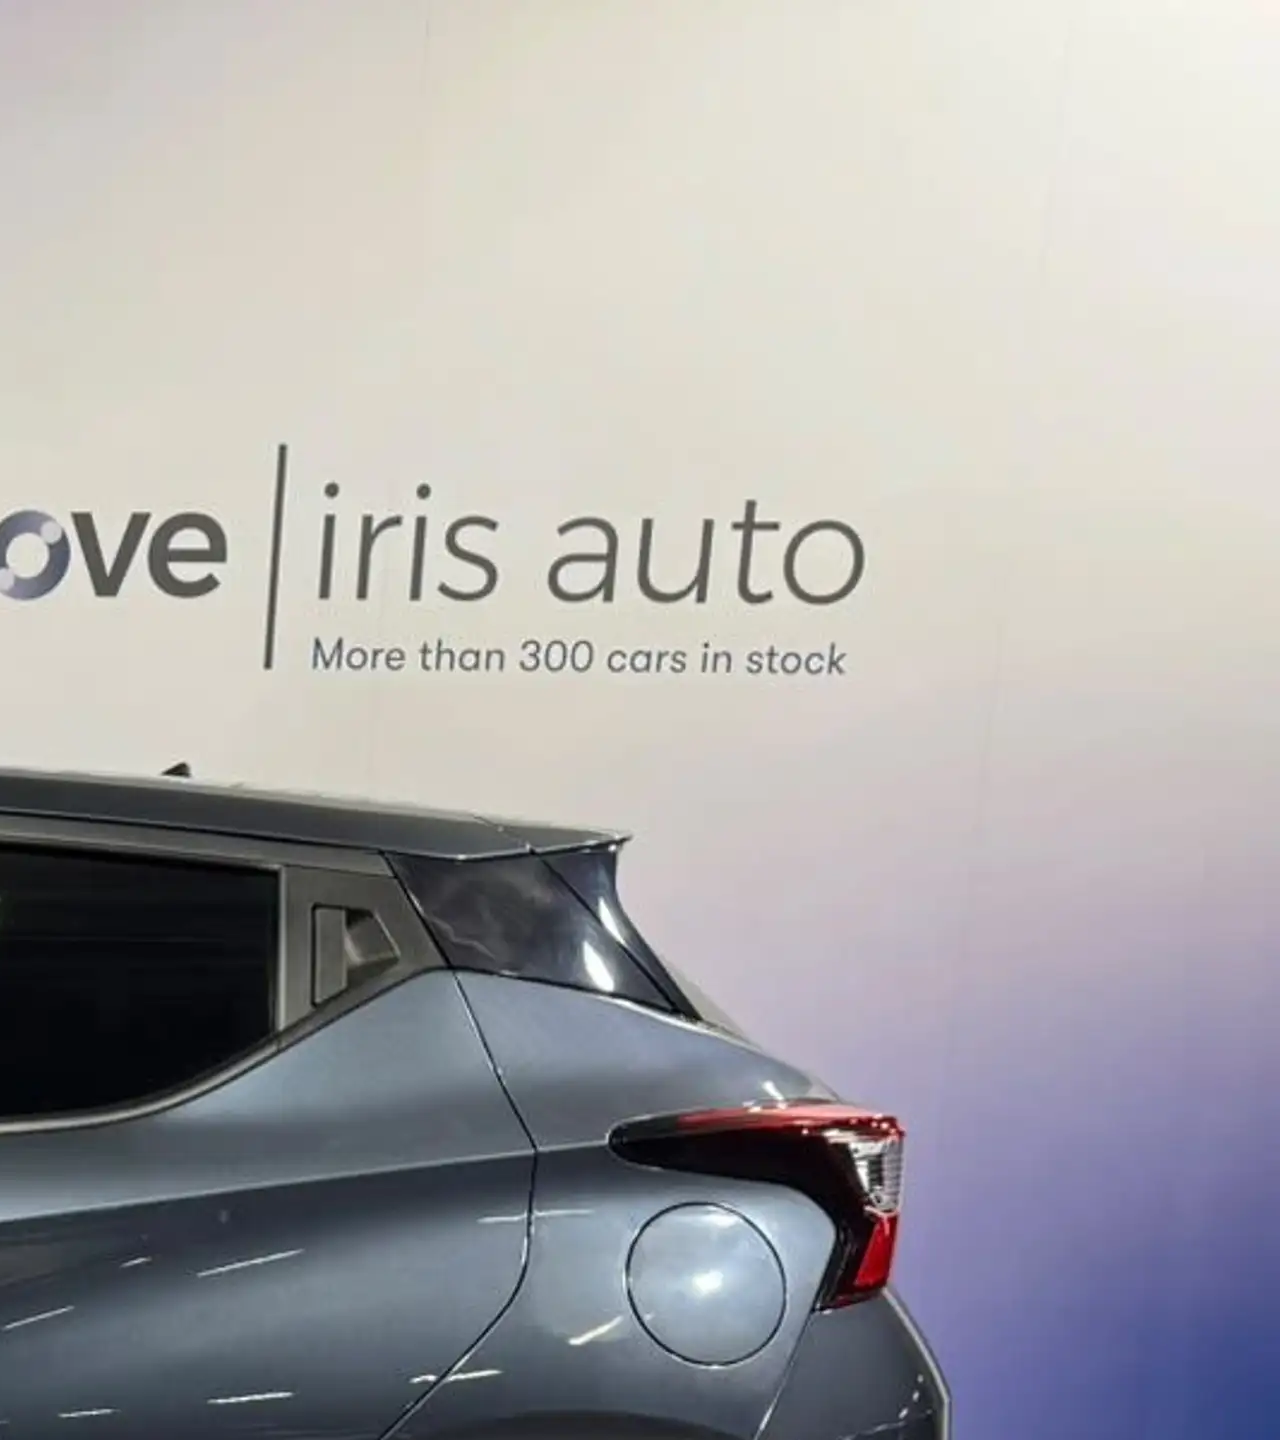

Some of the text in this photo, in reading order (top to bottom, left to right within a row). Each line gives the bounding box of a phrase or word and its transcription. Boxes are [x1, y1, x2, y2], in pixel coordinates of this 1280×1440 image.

[317, 481, 867, 606] iris auto
[311, 636, 848, 676] More than 300 cars in stock
